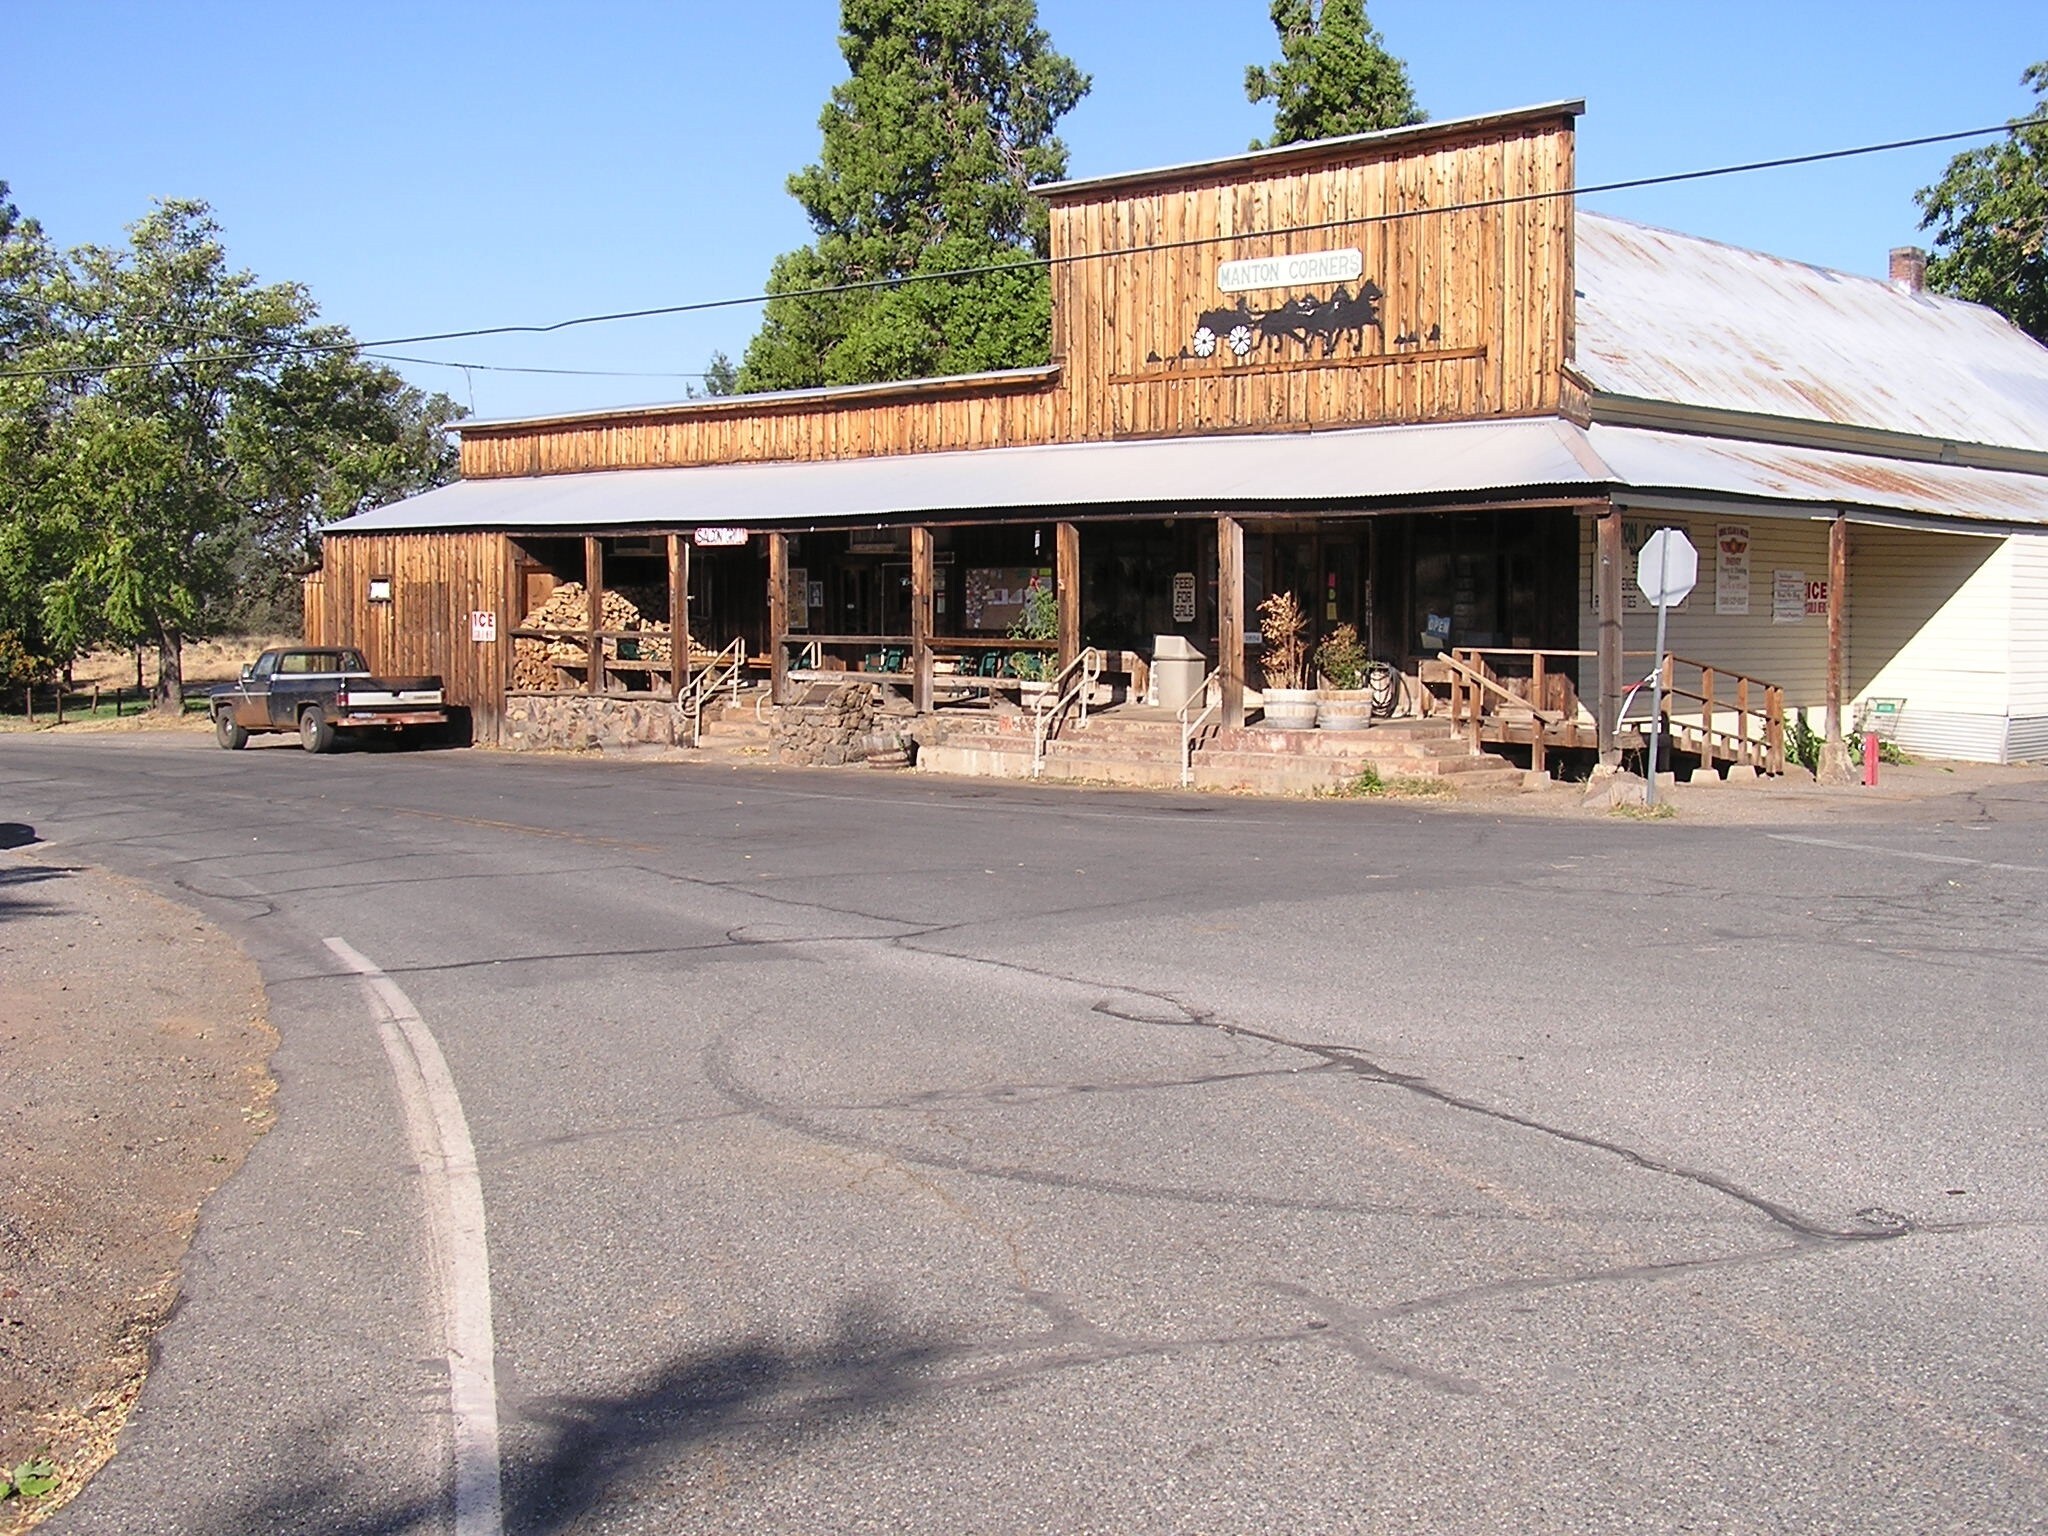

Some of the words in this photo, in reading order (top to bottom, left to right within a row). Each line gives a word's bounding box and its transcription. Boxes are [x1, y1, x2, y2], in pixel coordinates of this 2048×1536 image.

[1221, 262, 1280, 286] MANTON
[1288, 254, 1360, 279] CORNERS
[1175, 577, 1193, 588] FEED
[1177, 591, 1191, 603] FOR
[1807, 582, 1827, 599] ICE
[1175, 604, 1193, 617] SALE
[474, 613, 493, 627] ICE
[1428, 619, 1450, 633] OPEN
